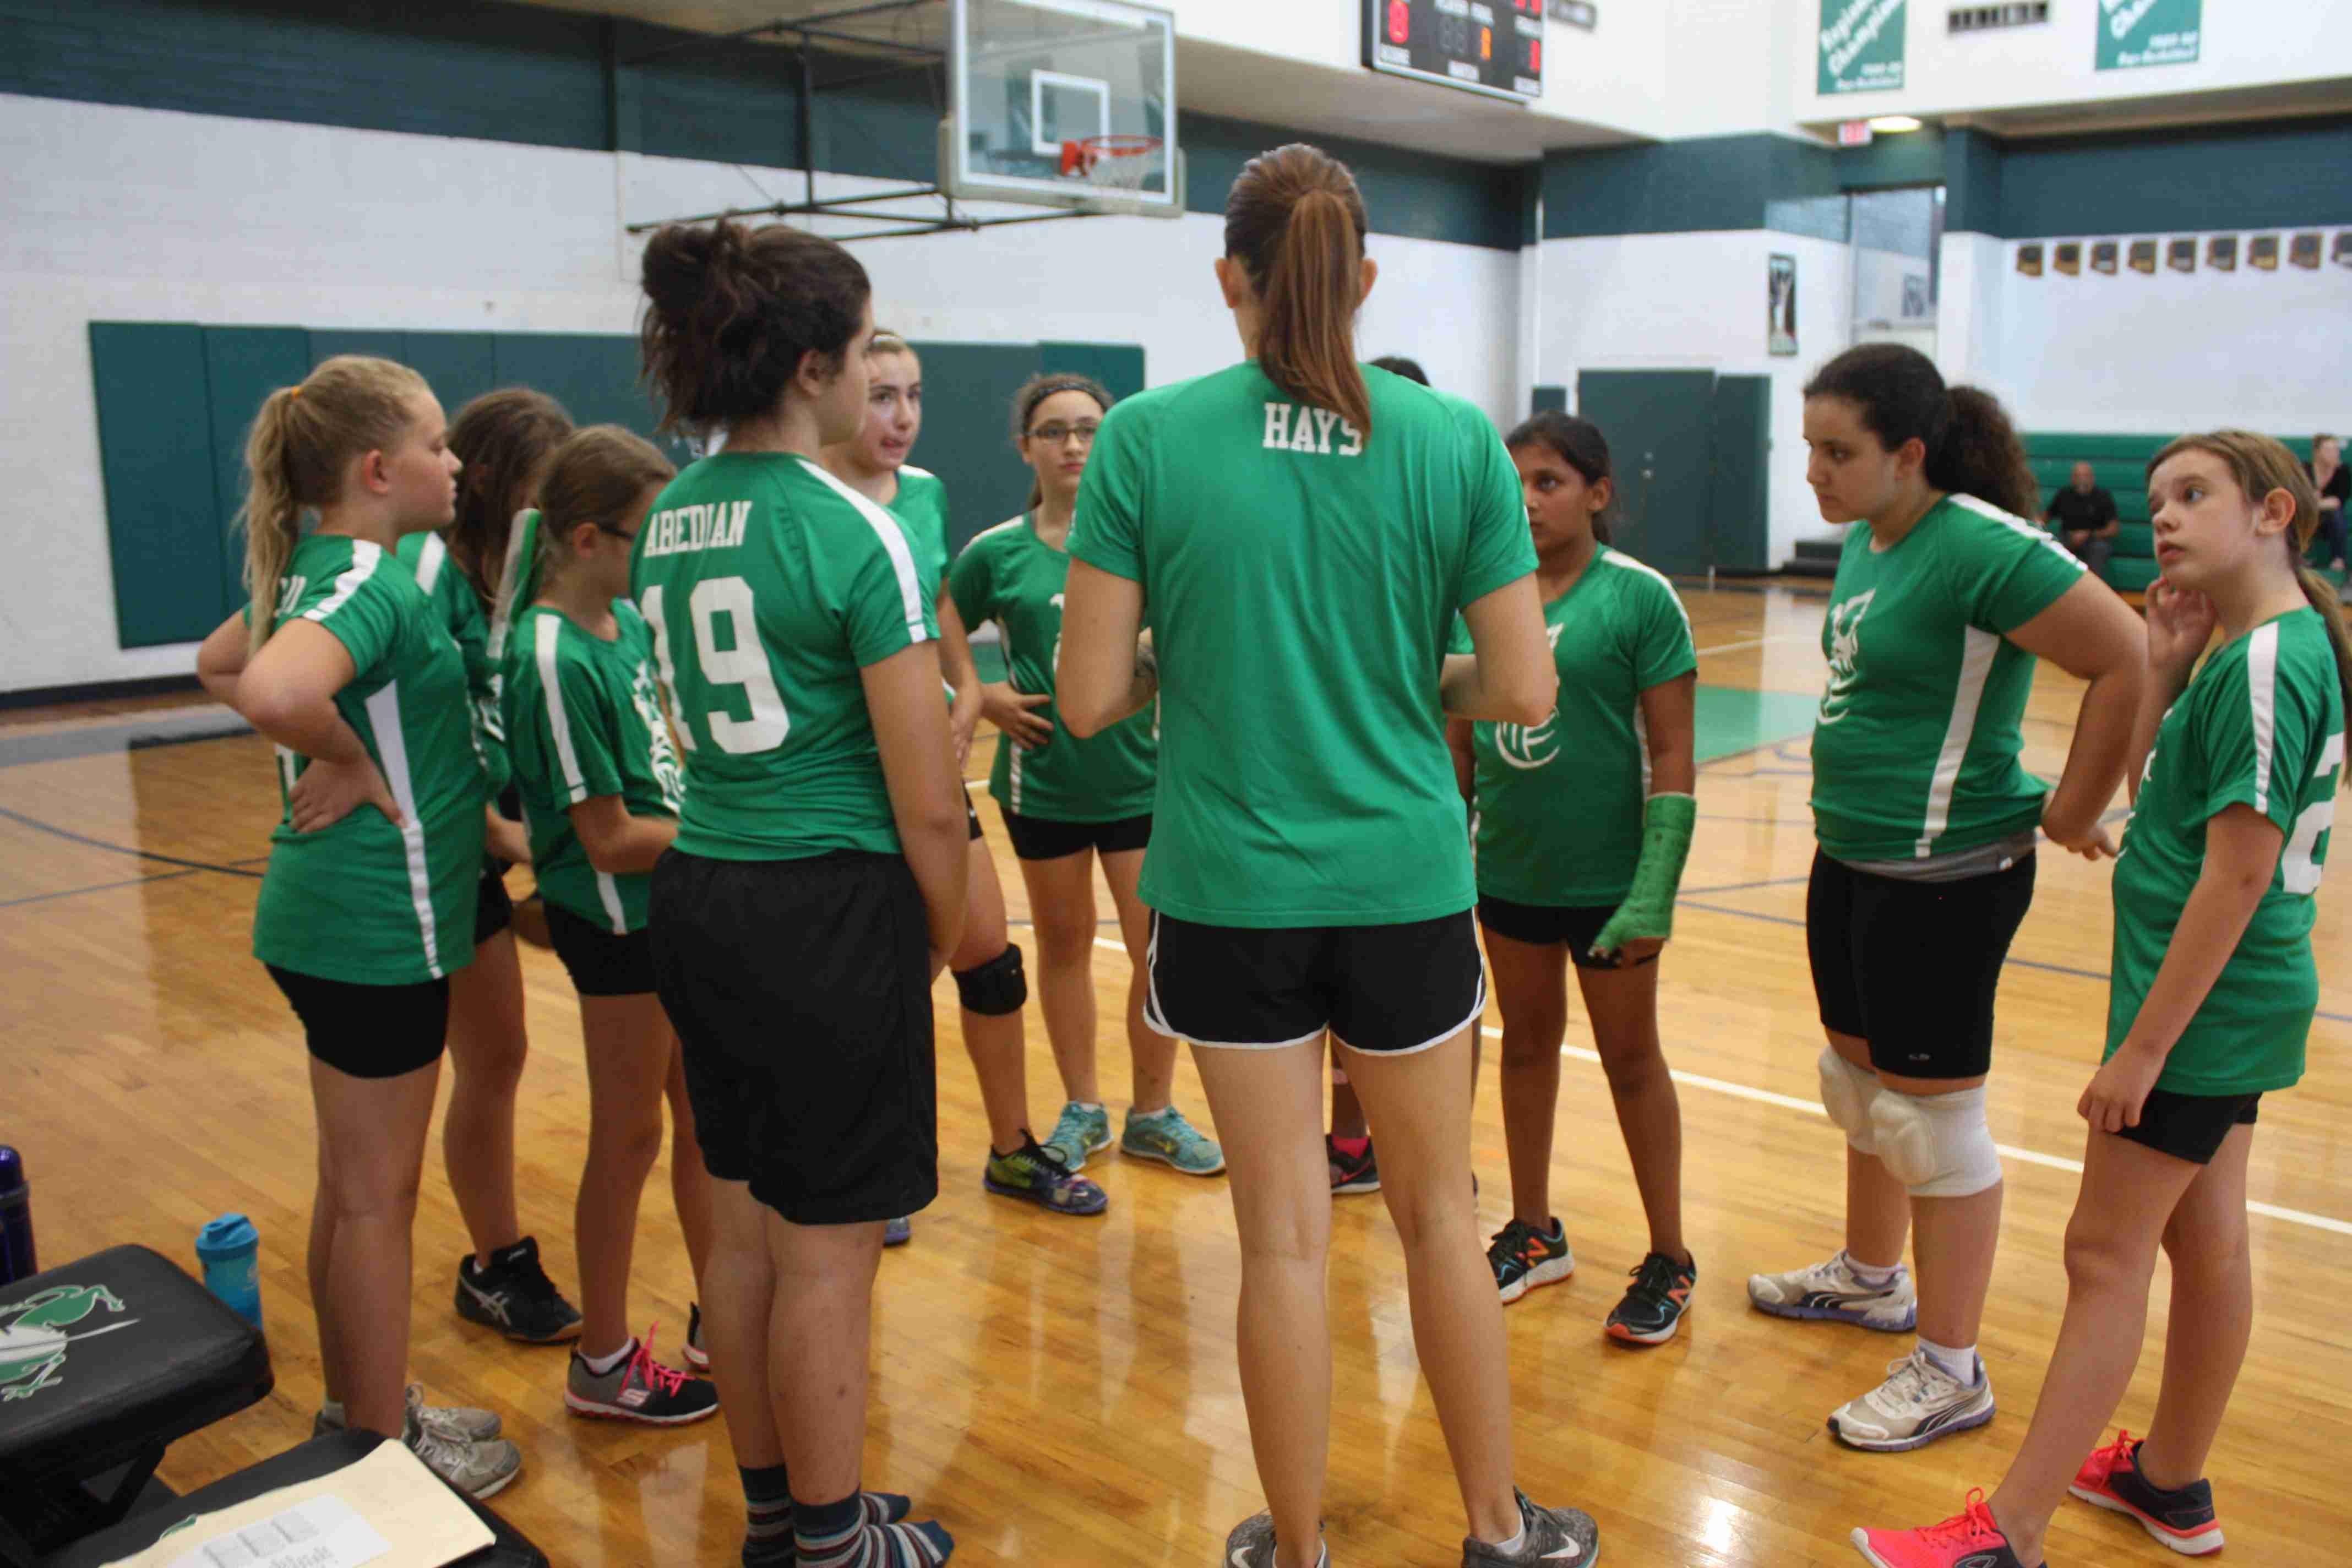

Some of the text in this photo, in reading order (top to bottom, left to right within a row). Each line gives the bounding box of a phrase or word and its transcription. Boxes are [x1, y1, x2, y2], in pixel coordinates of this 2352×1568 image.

[1262, 402, 1362, 456] HAYS
[643, 500, 753, 558] ABEDIAN
[640, 576, 790, 754] 19
